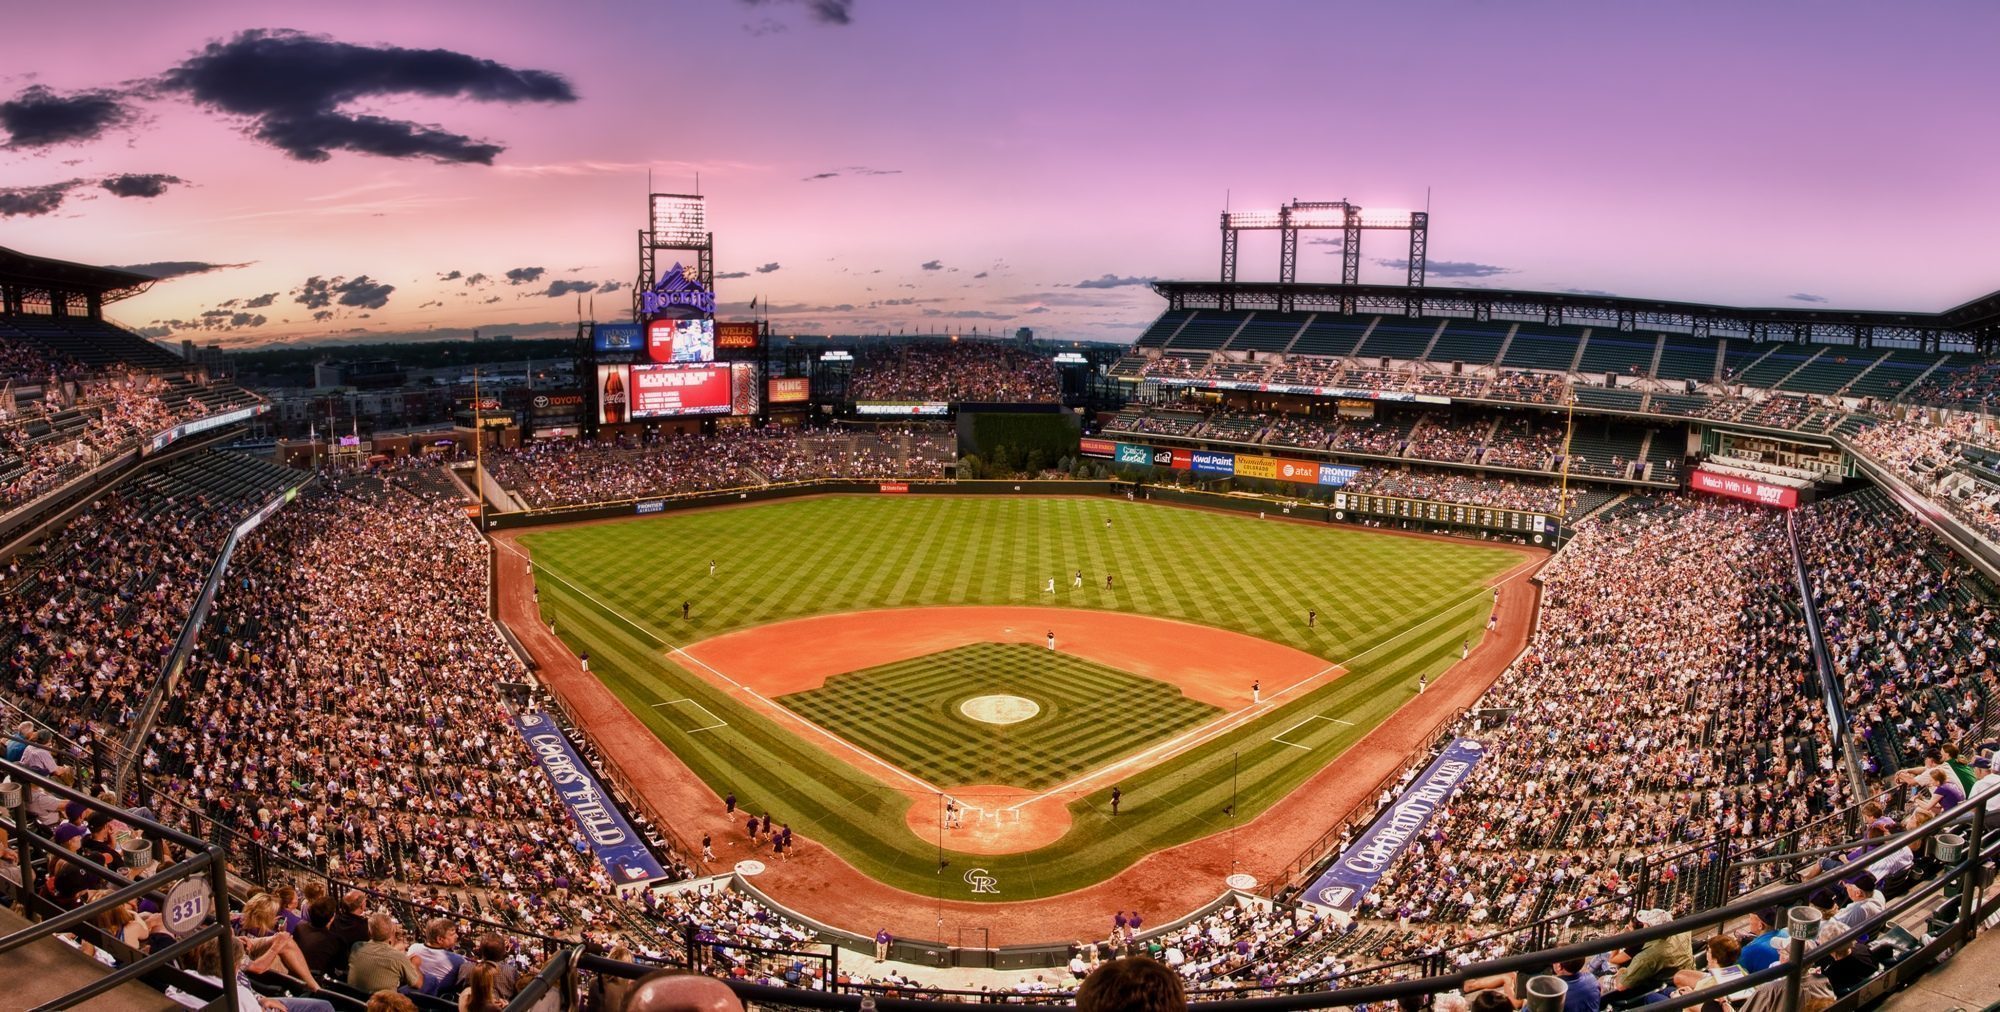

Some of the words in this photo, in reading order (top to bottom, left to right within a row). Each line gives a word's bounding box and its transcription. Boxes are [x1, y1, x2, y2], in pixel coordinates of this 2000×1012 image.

[642, 291, 716, 313] ROCKIES
[720, 326, 753, 336] WELLS
[721, 336, 753, 345] FARGO
[735, 366, 750, 415] Coors
[777, 381, 802, 391] KING
[549, 395, 583, 405] TOYOTA
[486, 417, 512, 425] TUNDRA
[1098, 443, 1116, 451] FARGO
[1121, 451, 1147, 464] dental
[1154, 452, 1172, 463] dish
[1193, 455, 1211, 464] Kwal
[1236, 469, 1276, 478] WHISKEY
[1295, 467, 1312, 477] at&t
[1320, 467, 1358, 477] FRONTIE
[1703, 476, 1723, 489] Watch
[1725, 480, 1740, 492] With
[1742, 484, 1752, 495] Us
[1756, 485, 1784, 500] ROOT
[637, 502, 663, 510] FRONTIER
[530, 733, 583, 785] COORS
[563, 786, 626, 846] FIELD
[1345, 801, 1433, 873] COLORADO
[1408, 759, 1470, 805] ROCKIES
[172, 897, 201, 923] 331
